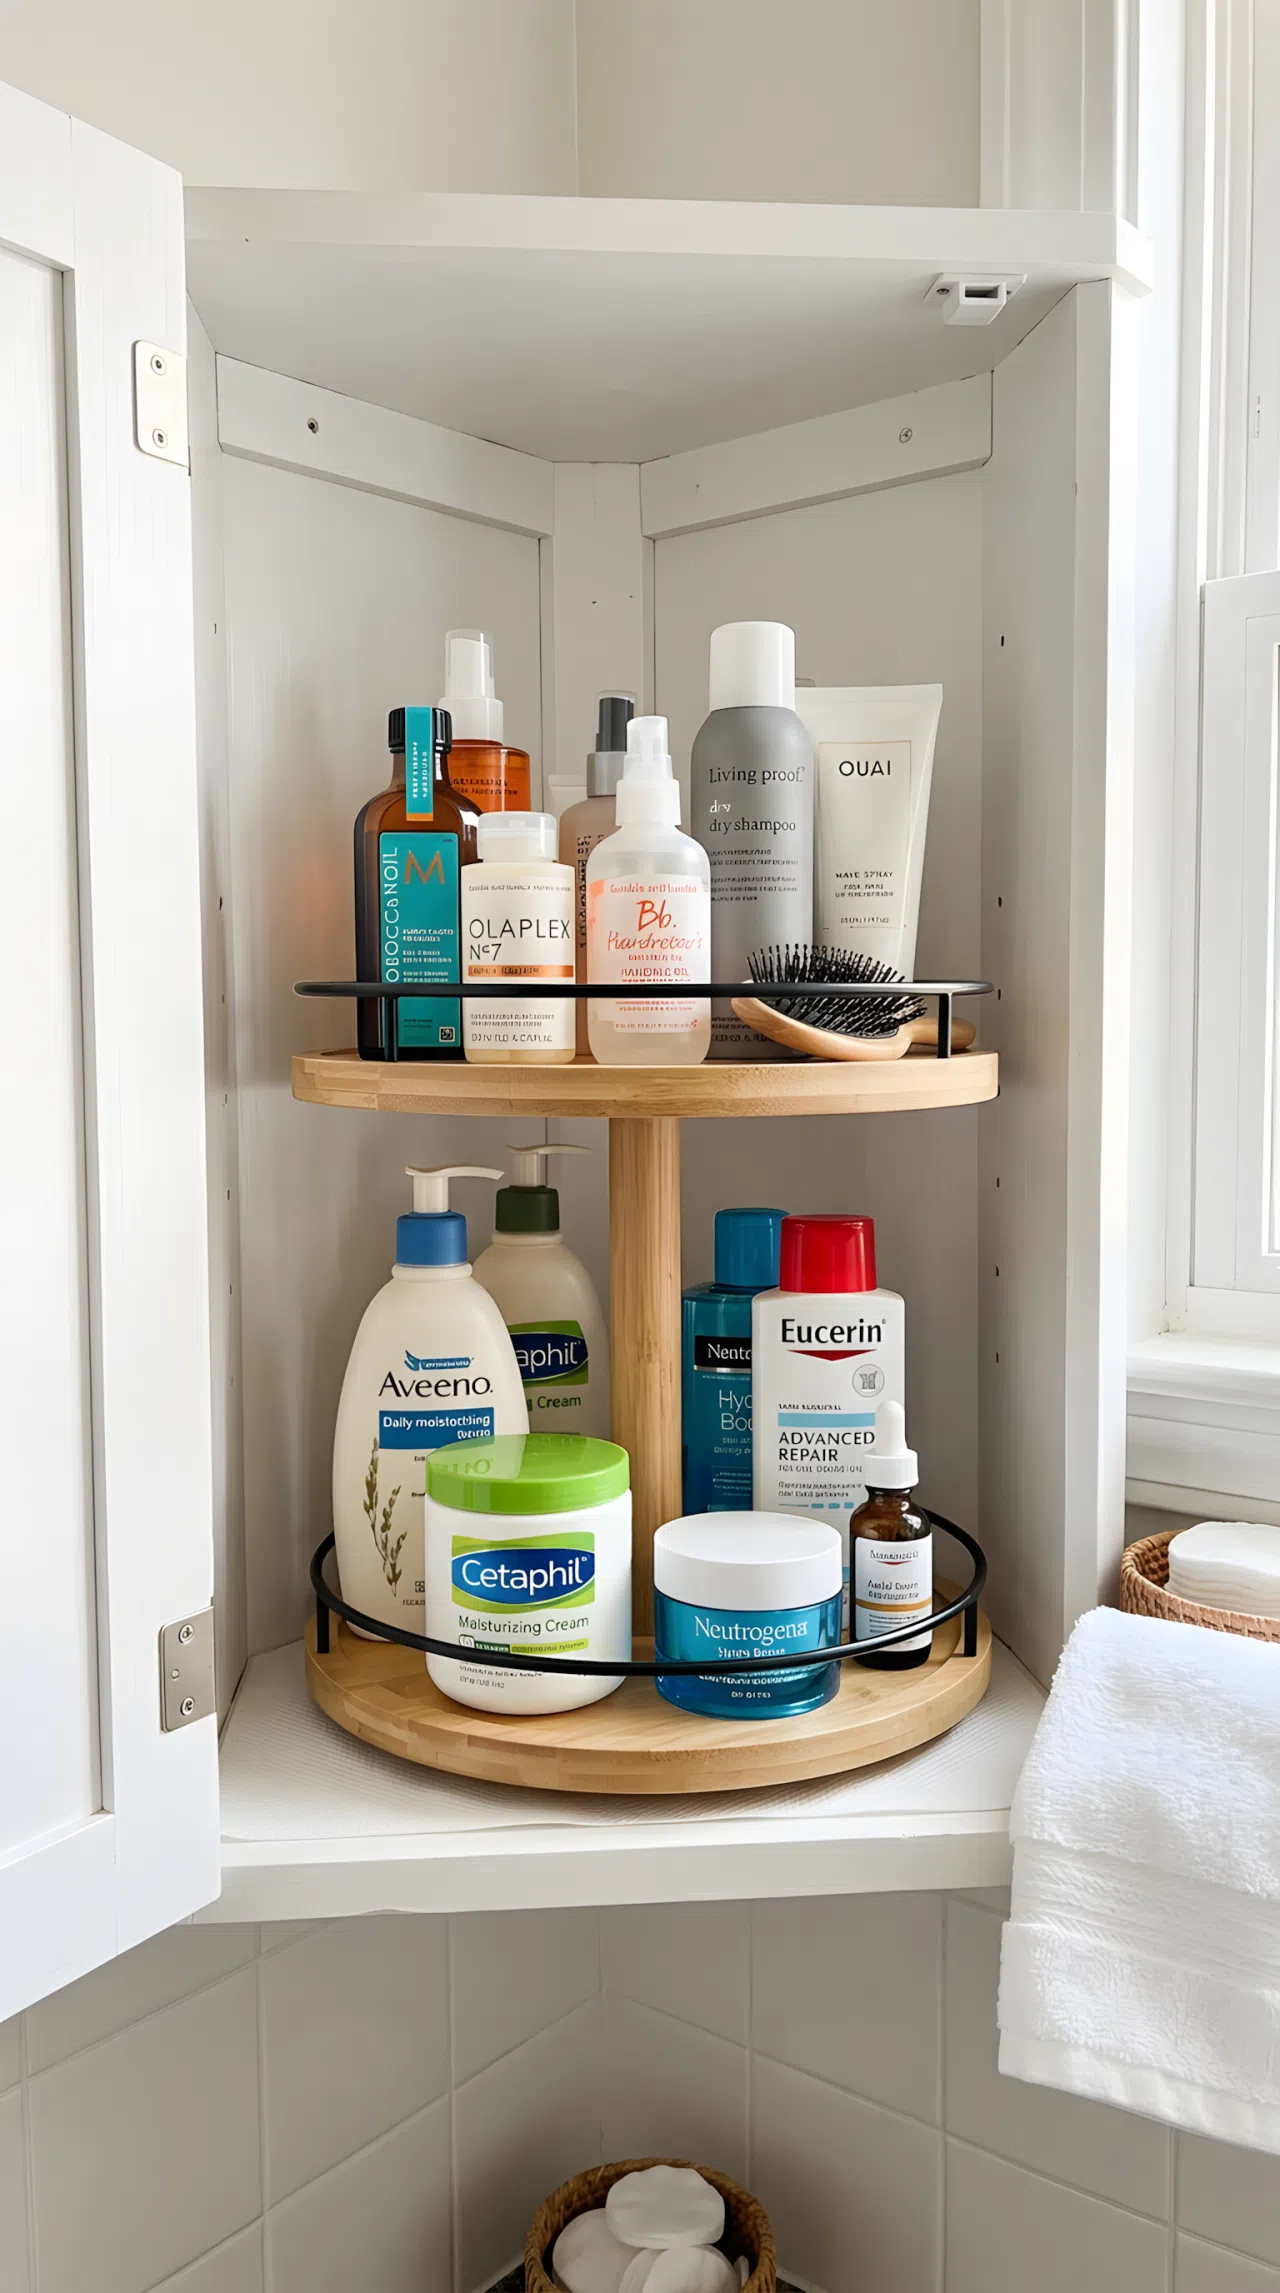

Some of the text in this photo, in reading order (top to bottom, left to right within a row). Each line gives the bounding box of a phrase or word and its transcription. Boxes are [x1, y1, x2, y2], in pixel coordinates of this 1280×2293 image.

[709, 766, 757, 785] Living
[838, 760, 891, 777] OUAI
[709, 799, 731, 813] dry
[709, 816, 796, 835] dry shampoo
[403, 849, 445, 885] M
[469, 918, 570, 939] OLAPLEX
[781, 1318, 882, 1344] Eucerin
[515, 1341, 579, 1374] aphil
[537, 1395, 581, 1409] Cream
[779, 1431, 875, 1445] ADVANCED
[779, 1448, 838, 1462] REPAIR
[461, 1556, 584, 1596] Cetaphil
[545, 1617, 589, 1632] Cream
